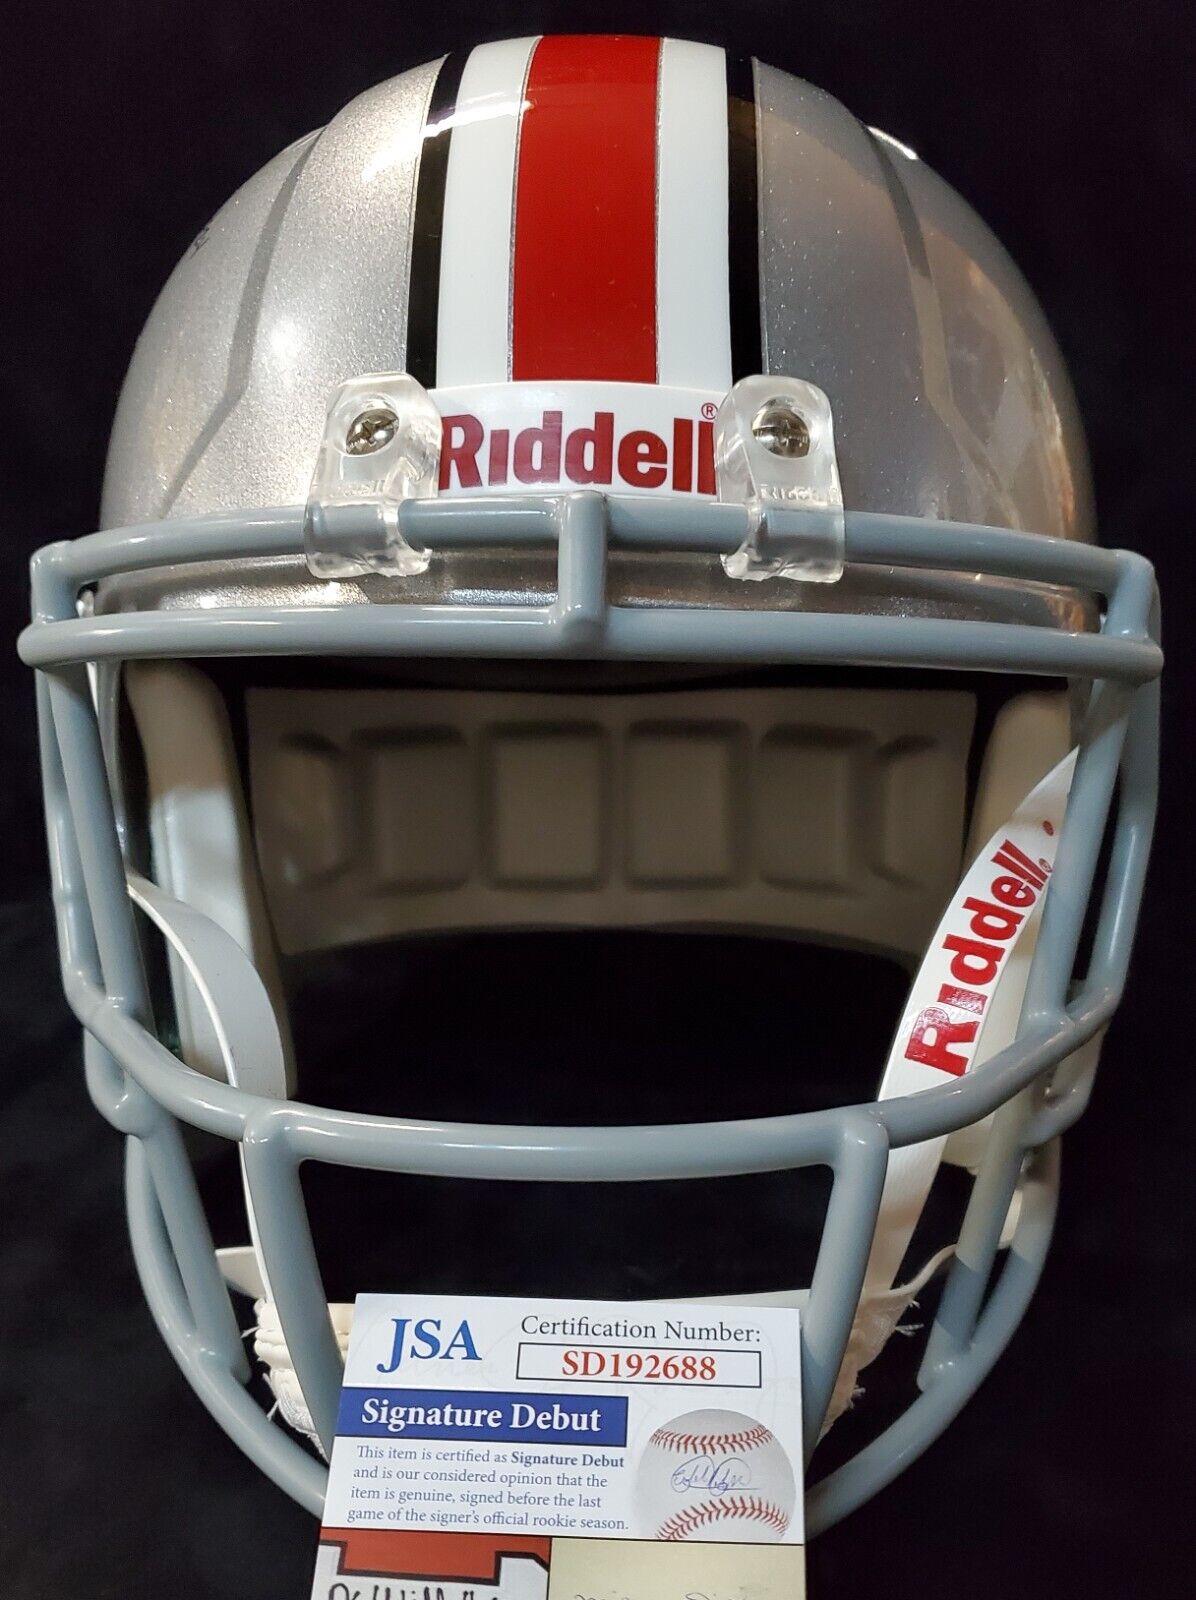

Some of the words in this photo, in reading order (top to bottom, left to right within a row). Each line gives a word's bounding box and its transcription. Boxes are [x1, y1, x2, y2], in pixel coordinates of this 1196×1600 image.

[438, 410, 717, 496] Riddell
[904, 839, 1050, 1077] Riddell
[520, 1315, 656, 1339] Certification
[664, 1320, 761, 1342] Number:
[376, 1318, 483, 1373] JSA
[561, 1350, 717, 1381] SD192688
[361, 1398, 503, 1432] Signature
[509, 1404, 602, 1432] Debut
[357, 1445, 385, 1459] This
[388, 1446, 417, 1460] item
[421, 1448, 432, 1460] is
[435, 1448, 490, 1462] certified
[494, 1453, 508, 1463] as
[510, 1451, 578, 1468] Signature
[582, 1453, 625, 1467] Debut
[353, 1466, 379, 1479] and
[382, 1467, 393, 1479] is
[396, 1470, 420, 1480] our
[423, 1469, 496, 1483] considered
[500, 1472, 552, 1487] opinion
[556, 1473, 582, 1487] that
[586, 1474, 608, 1488] the
[350, 1486, 380, 1499] item
[384, 1487, 396, 1500] is
[398, 1489, 456, 1504] genuine,
[459, 1491, 503, 1507] signed
[507, 1491, 550, 1506] before
[554, 1493, 576, 1507] the
[578, 1494, 602, 1508] last
[346, 1508, 384, 1523] game
[387, 1507, 404, 1520] of
[405, 1508, 427, 1522] the
[429, 1510, 480, 1526] signer's
[483, 1511, 529, 1526] official
[533, 1514, 577, 1528] rookie
[580, 1517, 629, 1530] season.
